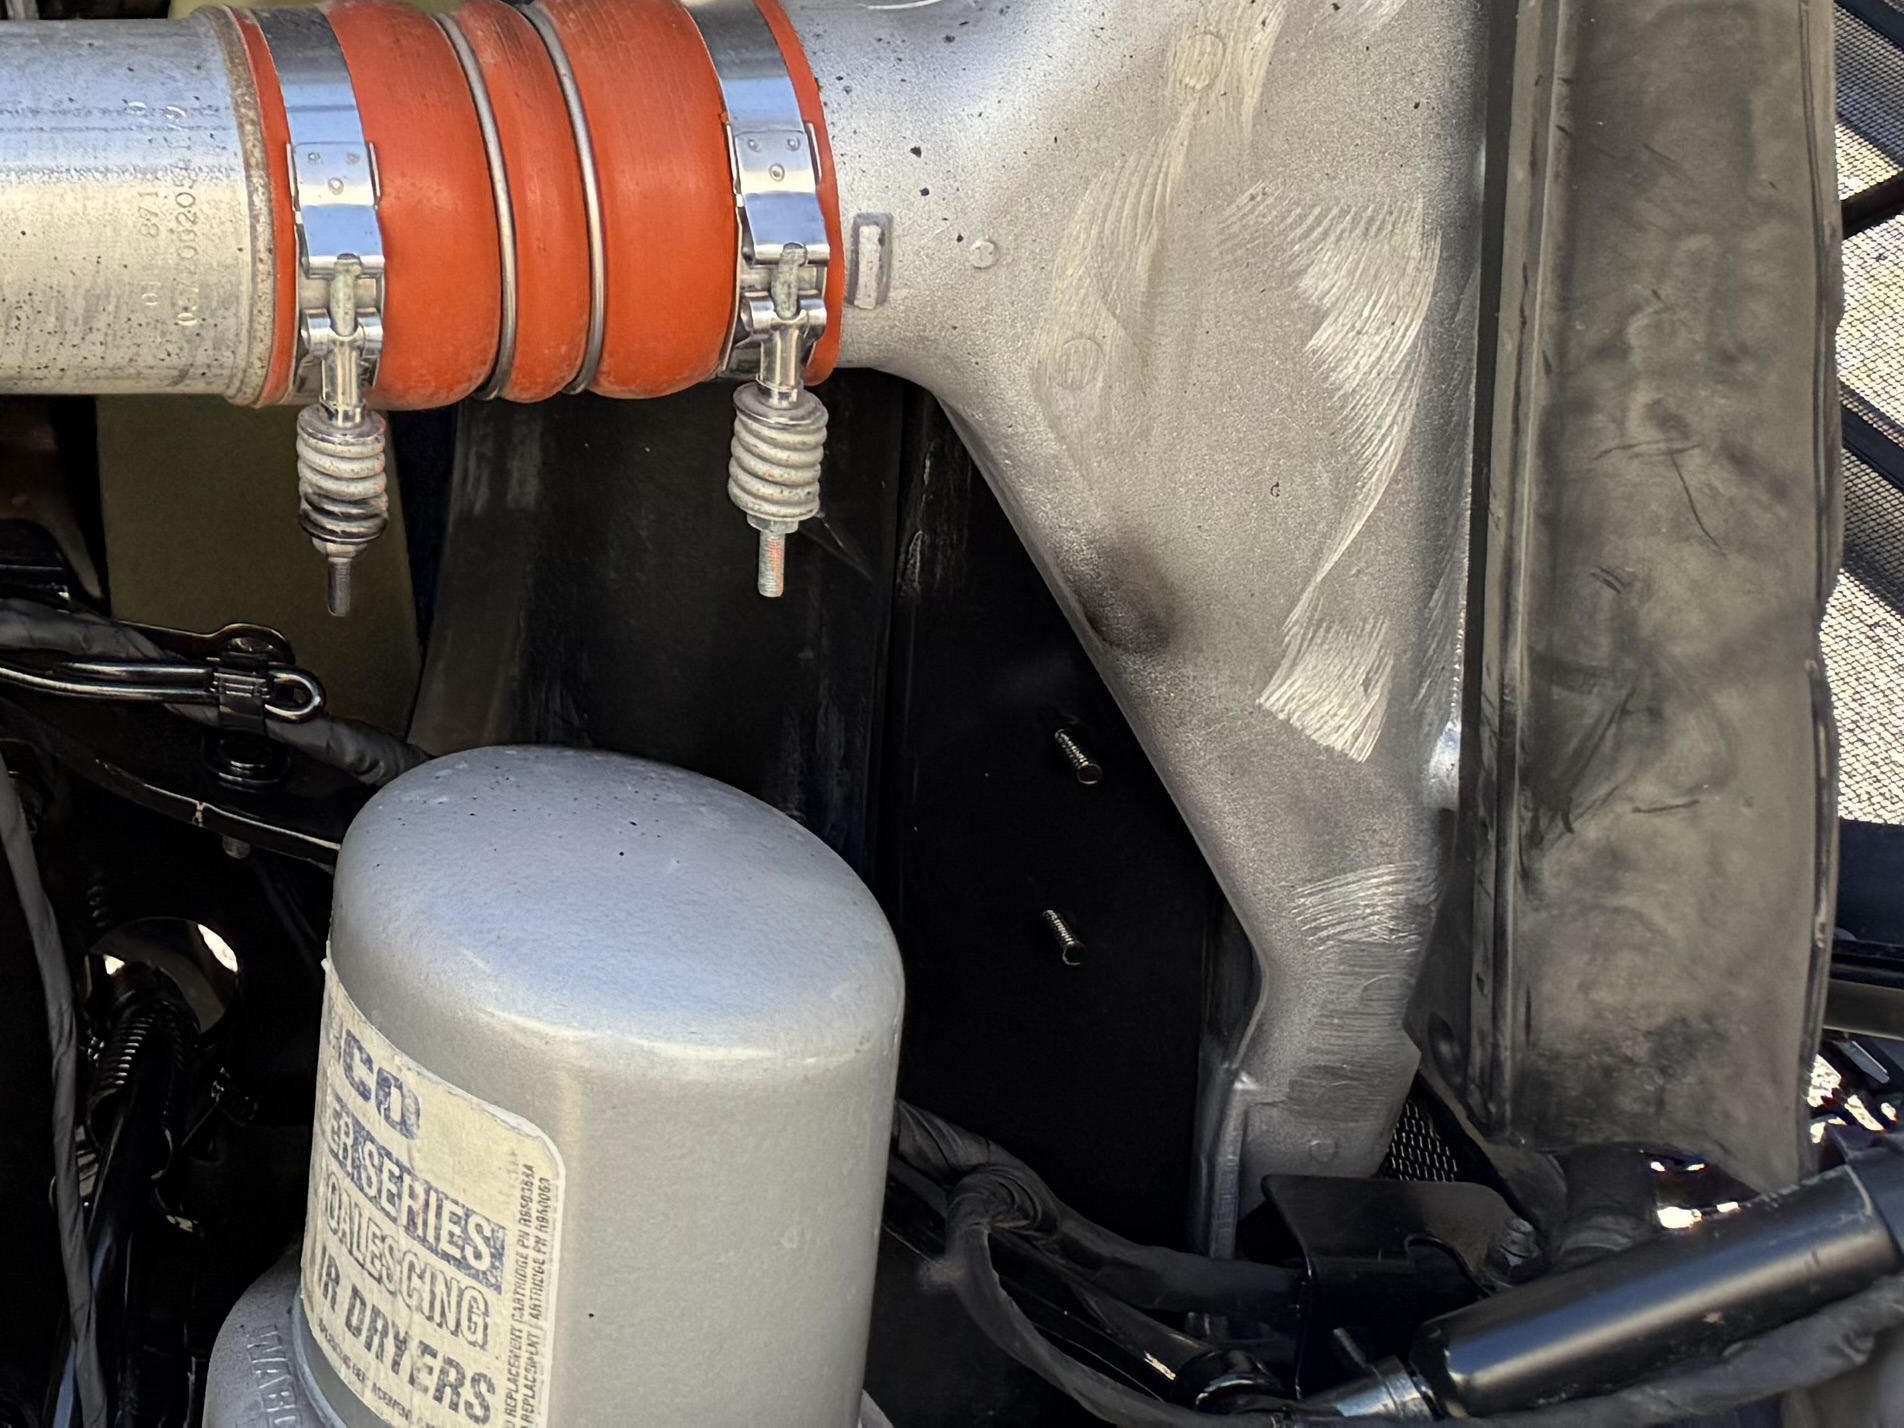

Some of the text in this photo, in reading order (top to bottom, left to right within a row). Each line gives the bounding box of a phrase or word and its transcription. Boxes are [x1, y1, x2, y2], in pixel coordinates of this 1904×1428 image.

[324, 1171, 490, 1352] OALESCING
[358, 1139, 494, 1273] SERIES
[344, 1283, 496, 1416] DRYERS
[503, 1325, 525, 1418] REPLACEMENT
[521, 1330, 542, 1424] REPLACEMENT
[532, 1256, 547, 1321] ARTRIDGE
